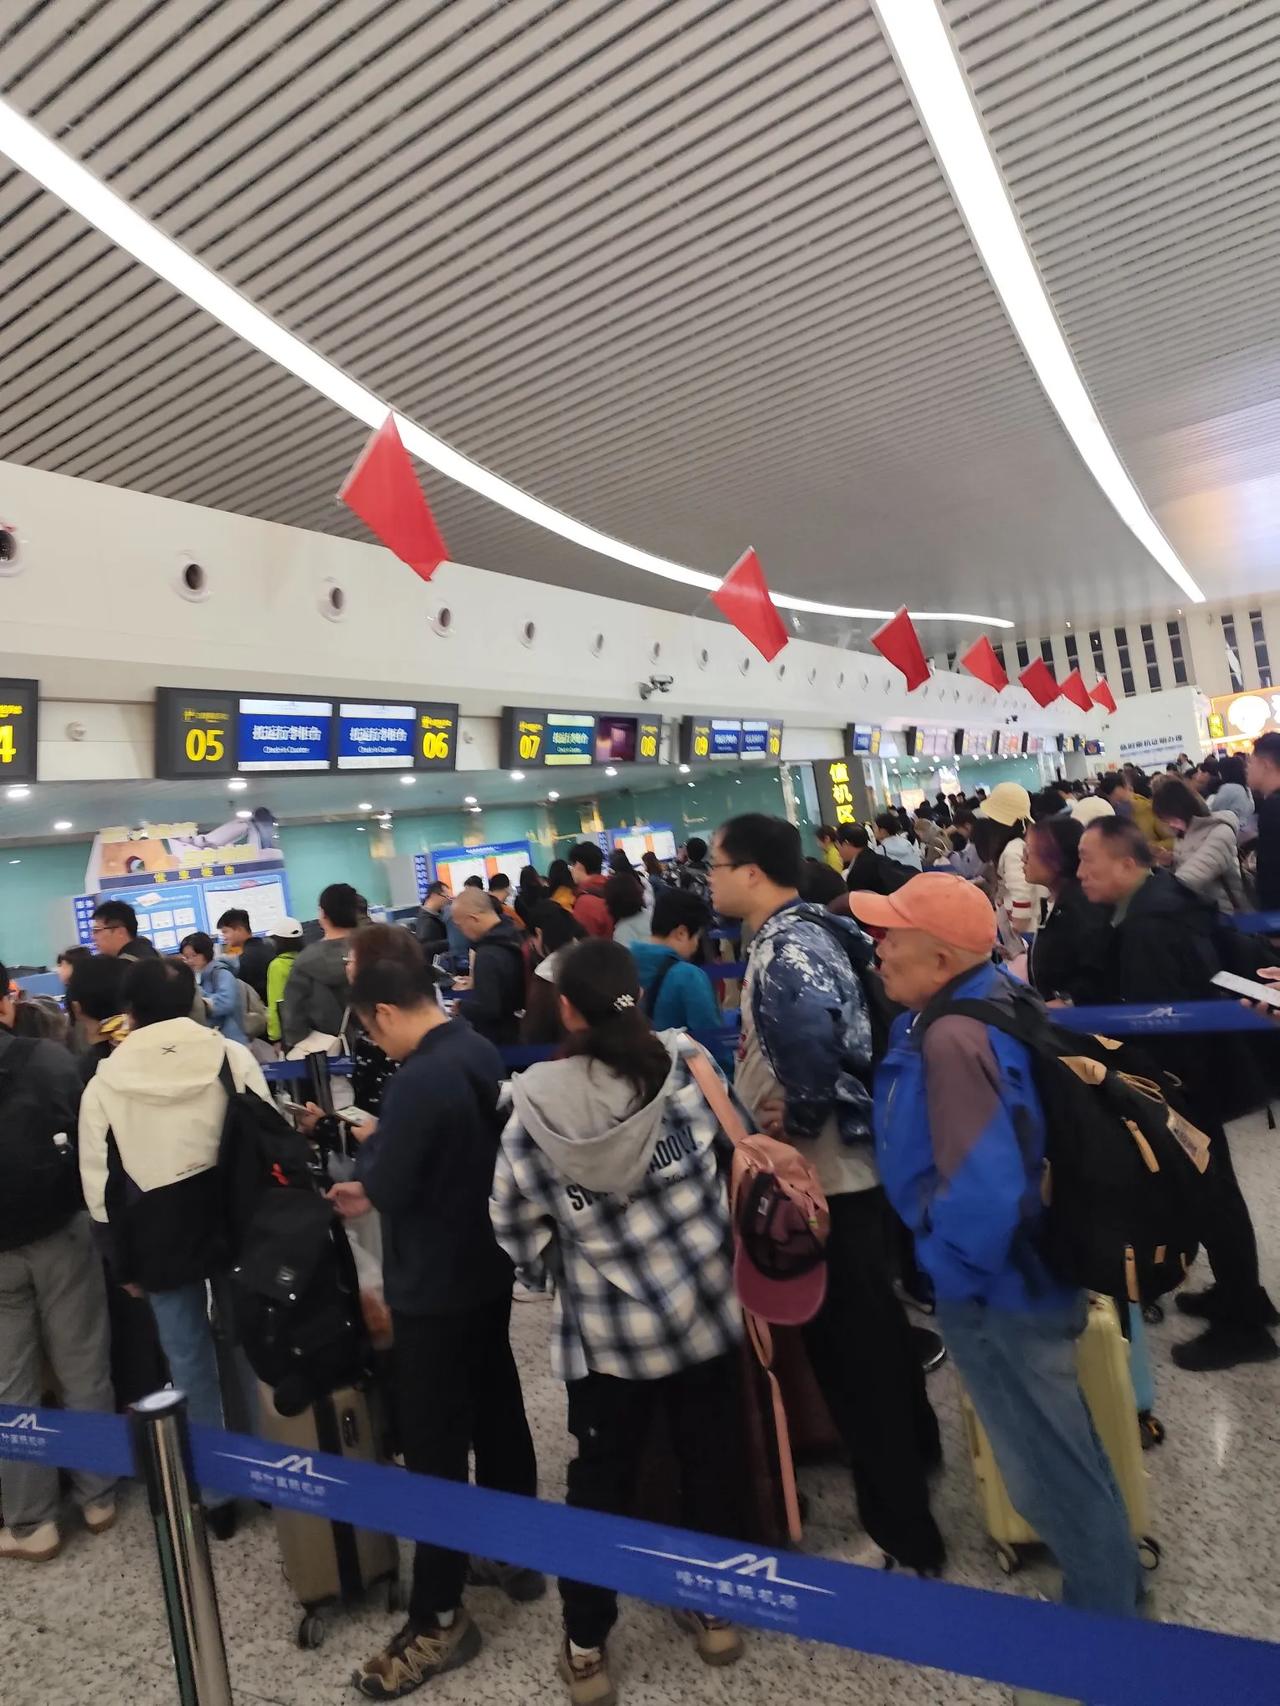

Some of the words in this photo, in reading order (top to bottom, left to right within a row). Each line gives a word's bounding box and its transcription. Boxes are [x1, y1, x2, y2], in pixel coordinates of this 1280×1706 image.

[186, 728, 225, 762] 05
[422, 731, 449, 760] 06
[519, 734, 541, 760] 07
[640, 735, 657, 757] 08
[829, 762, 856, 824] 值机区
